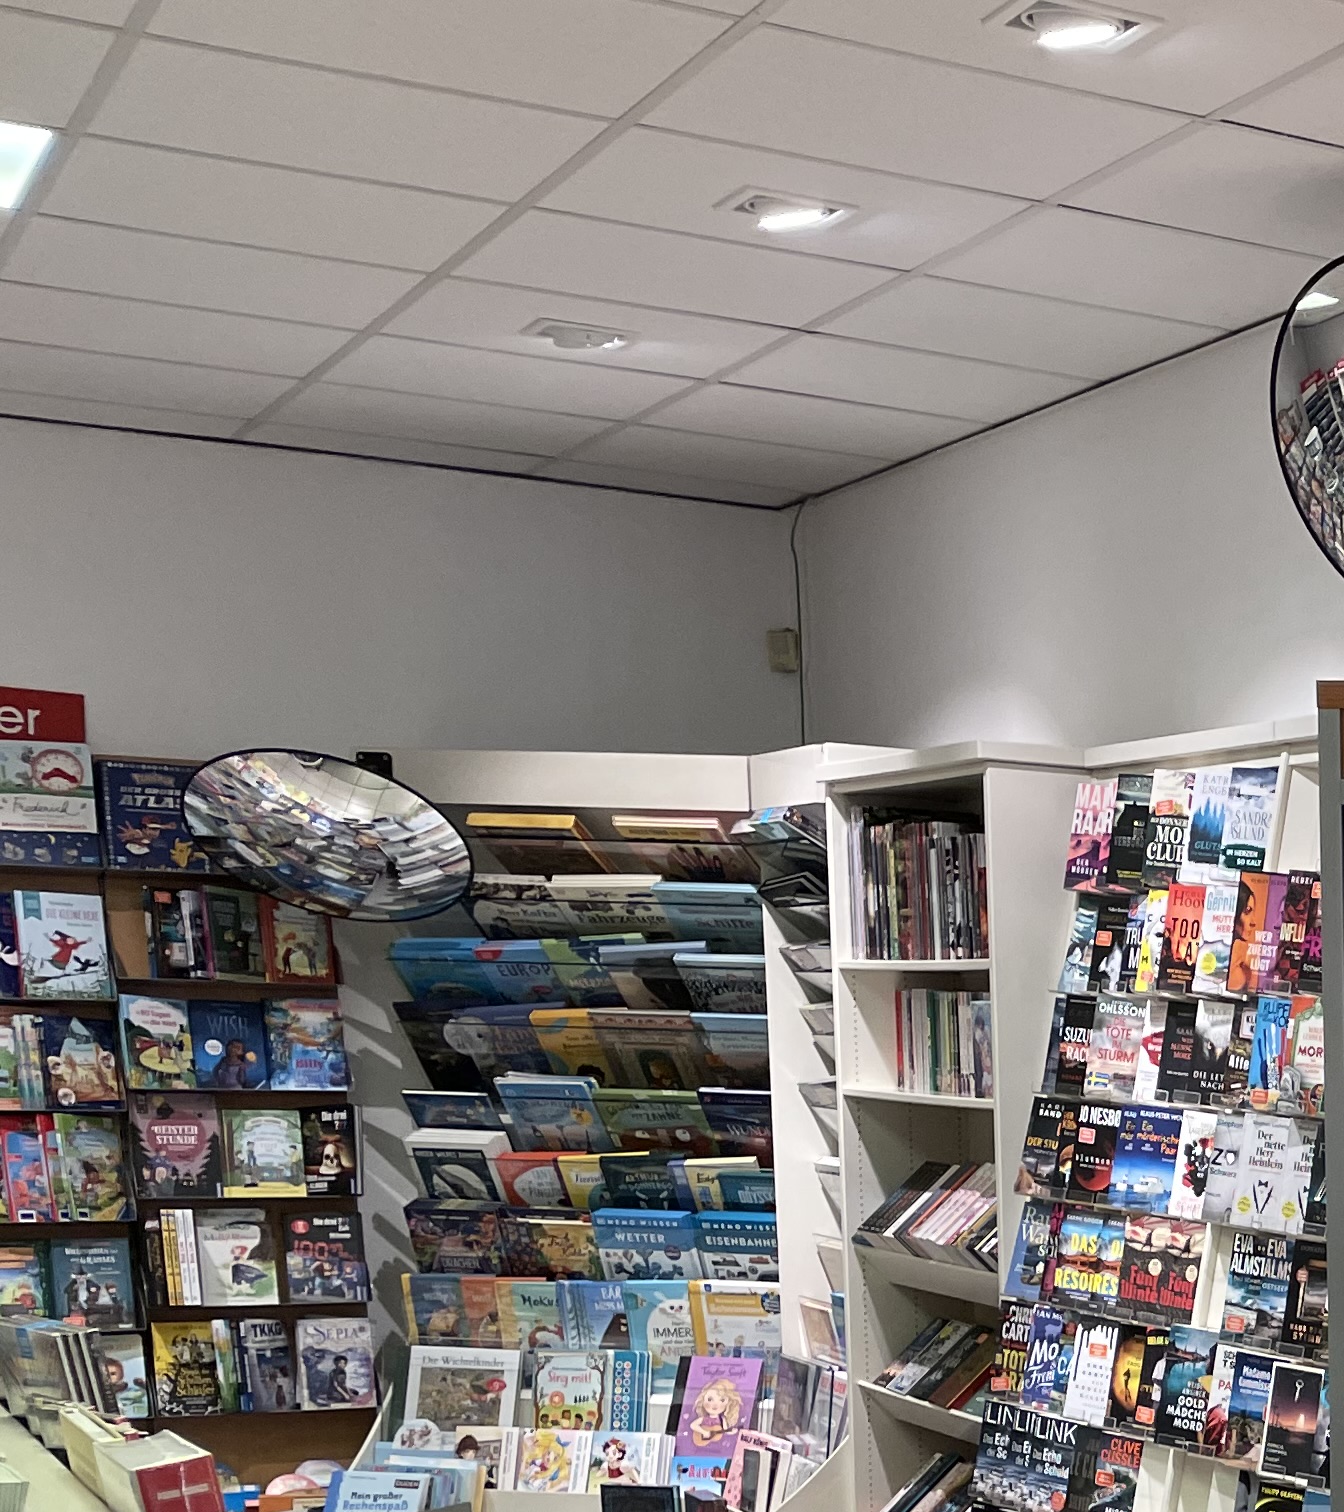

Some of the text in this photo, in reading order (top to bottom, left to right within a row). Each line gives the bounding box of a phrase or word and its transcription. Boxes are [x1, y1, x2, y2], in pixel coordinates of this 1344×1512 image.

[1172, 918, 1201, 941] TOO
[208, 1015, 250, 1036] WISH
[1106, 1026, 1133, 1041] TOTE
[1096, 1048, 1135, 1064] STURM
[154, 1125, 198, 1135] GEISTER
[155, 1135, 198, 1146] STUNDE
[614, 1232, 667, 1245] WETTER
[251, 1323, 283, 1338] TKKG
[421, 1355, 438, 1367] Die
[547, 1371, 571, 1387] Sing
[1178, 1396, 1206, 1410] GOLD
[1173, 1418, 1204, 1432] MORD
[1110, 1437, 1142, 1455] CLIVE
[350, 1491, 404, 1504] Mein großer
